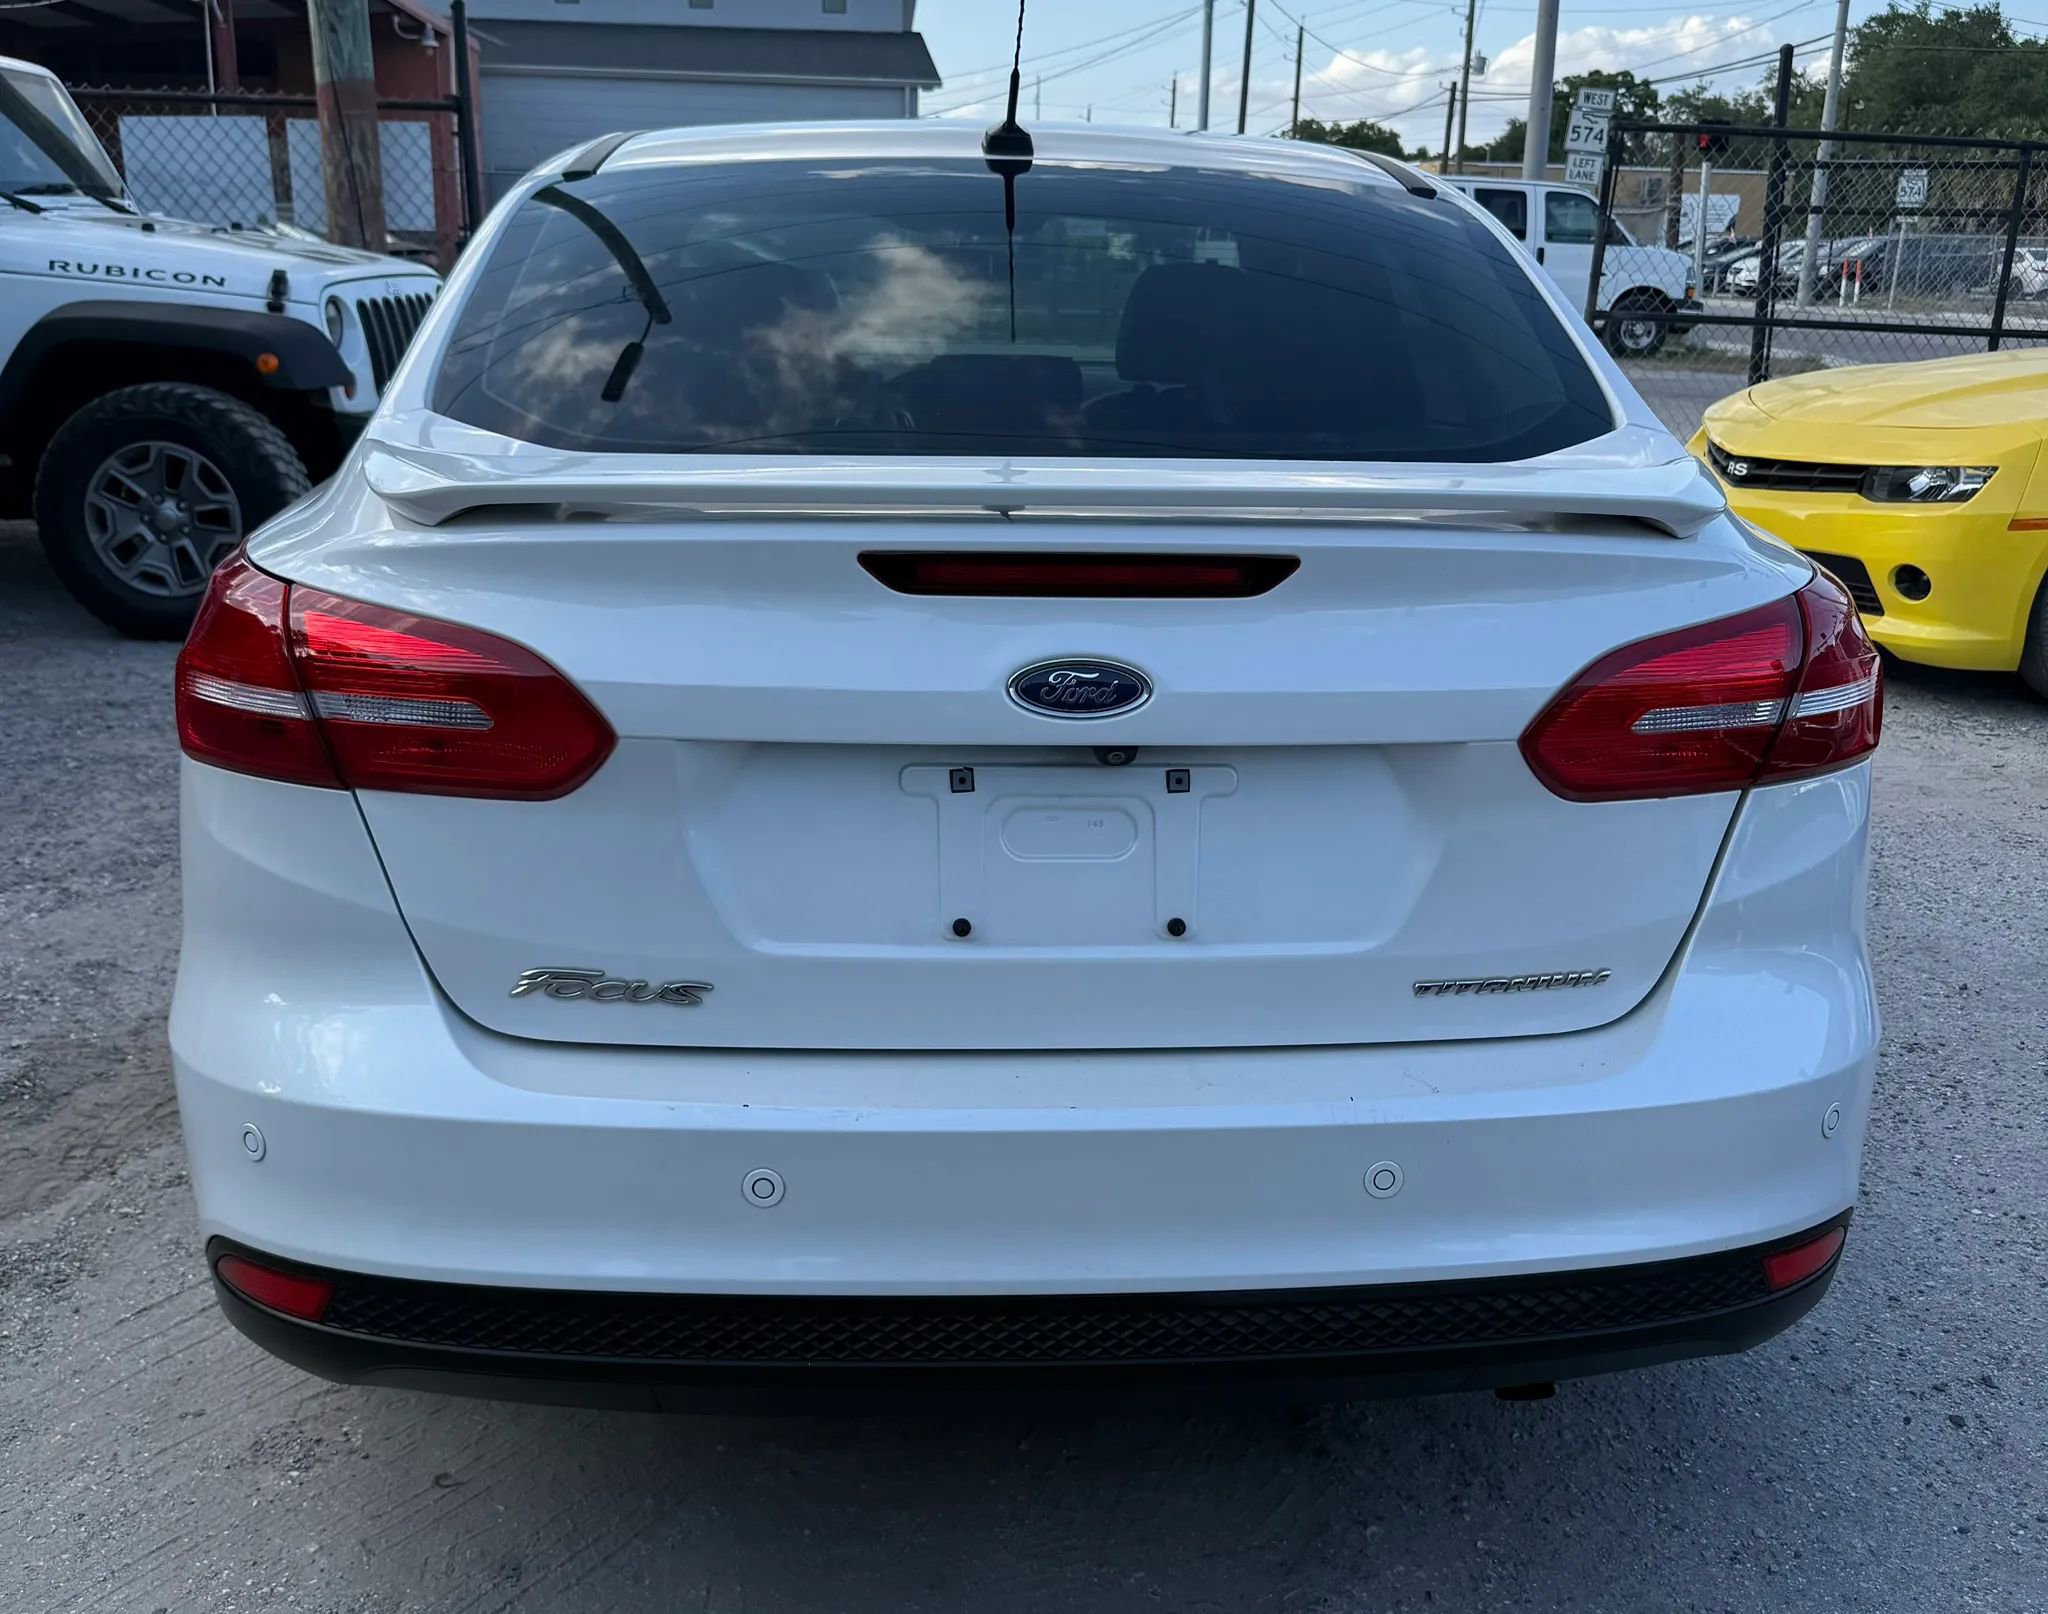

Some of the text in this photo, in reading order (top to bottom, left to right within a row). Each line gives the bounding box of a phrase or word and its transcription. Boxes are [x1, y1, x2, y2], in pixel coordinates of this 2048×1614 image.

[1583, 91, 1609, 106] WEST
[1570, 125, 1604, 144] 574
[1573, 157, 1596, 168] LEFT
[1569, 169, 1595, 181] LANE
[49, 260, 226, 287] RUBICON
[1727, 461, 1748, 476] RS
[1040, 670, 1119, 704] Ford
[509, 967, 714, 1006] Focus
[1413, 968, 1612, 997] TITANIUM
